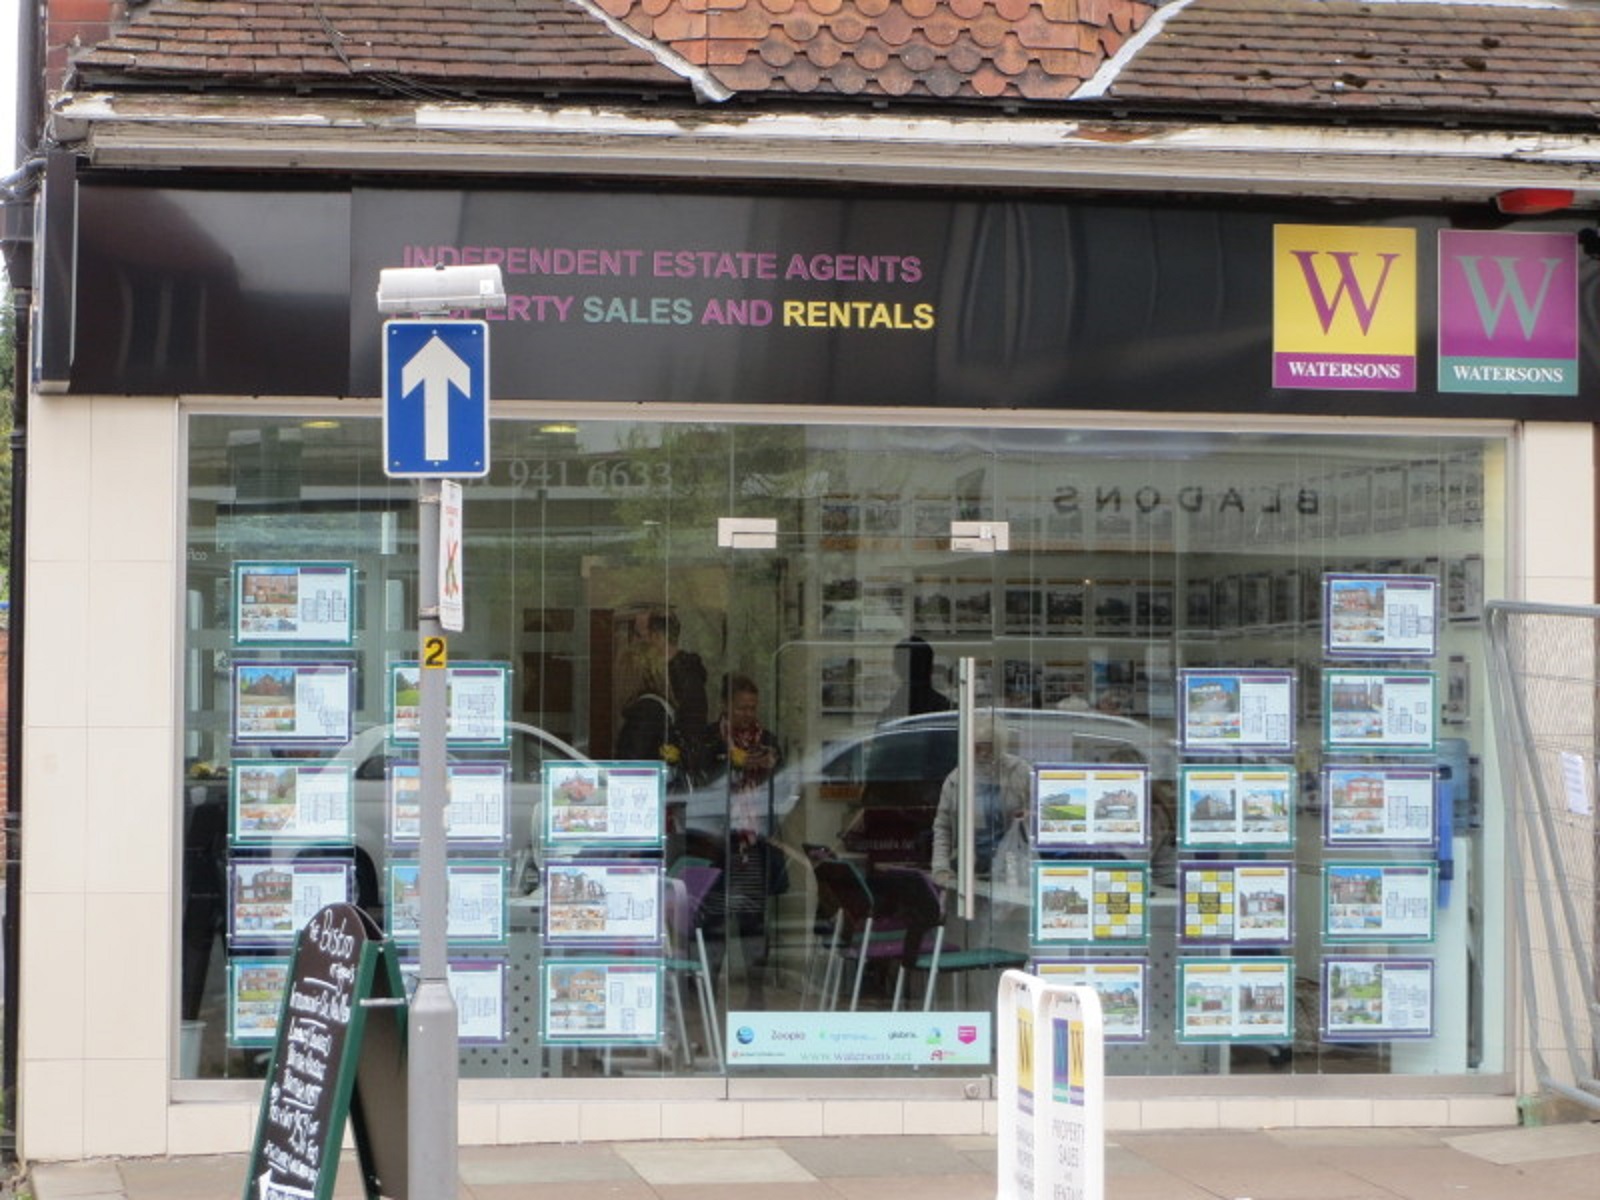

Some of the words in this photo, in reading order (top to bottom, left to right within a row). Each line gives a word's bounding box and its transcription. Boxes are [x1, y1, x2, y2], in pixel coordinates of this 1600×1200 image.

[653, 250, 776, 280] ESTATE
[785, 253, 922, 283] AGENTS
[1289, 250, 1400, 337] W
[1455, 255, 1563, 341] W
[583, 297, 693, 325] SALES
[701, 299, 773, 326] AND
[783, 301, 935, 329] RENTALS
[1288, 361, 1401, 380] WATERSONS
[1453, 364, 1563, 383] WATERSONS
[425, 637, 445, 667] 2
